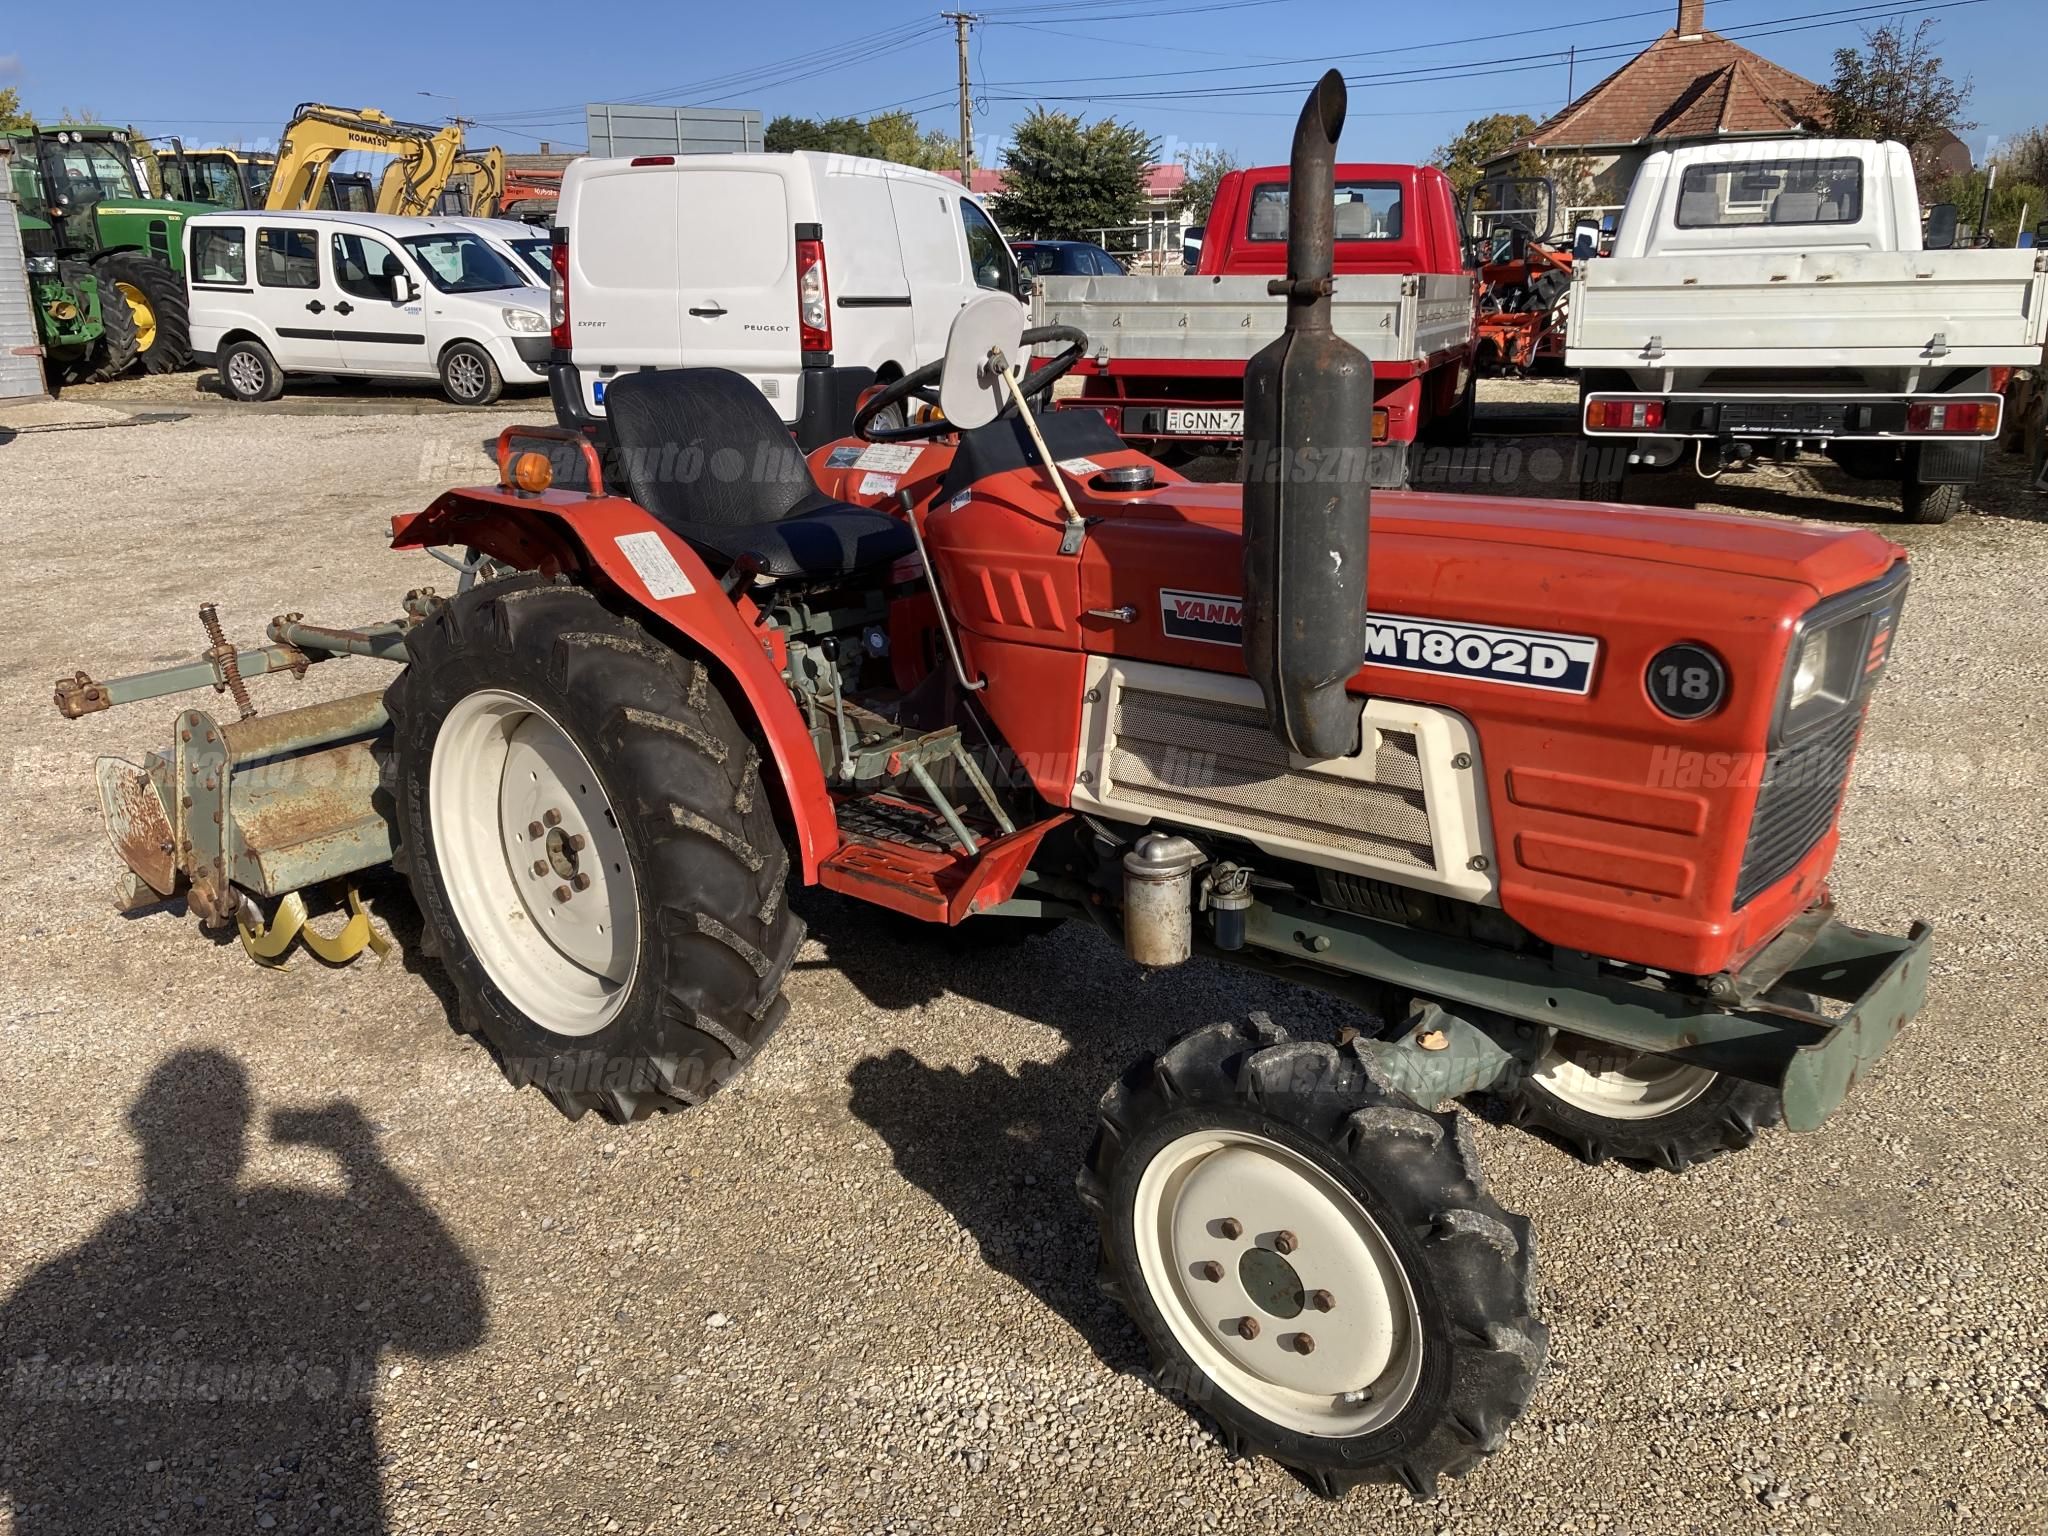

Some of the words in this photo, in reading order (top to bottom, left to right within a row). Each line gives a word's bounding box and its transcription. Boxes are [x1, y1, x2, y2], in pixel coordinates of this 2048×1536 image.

[349, 133, 388, 147] KOMATSU
[744, 324, 790, 332] PEUGEOT
[1183, 412, 1241, 430] GNN-7
[1174, 599, 1243, 627] YANM
[1365, 625, 1568, 679] M1802D
[1660, 665, 1710, 700] 18
